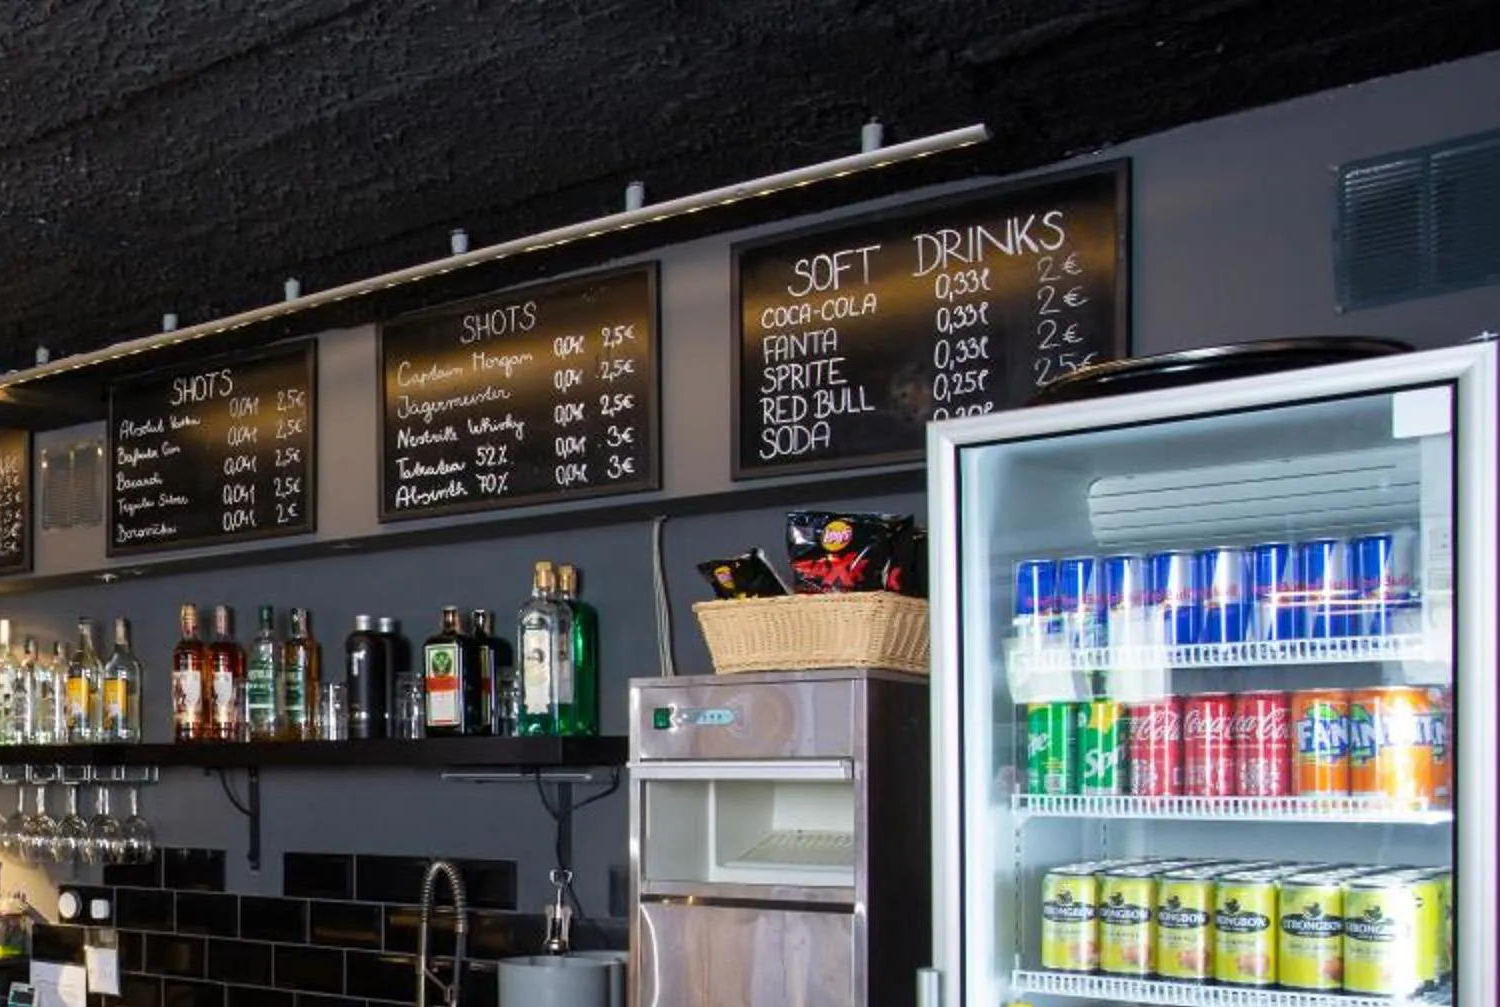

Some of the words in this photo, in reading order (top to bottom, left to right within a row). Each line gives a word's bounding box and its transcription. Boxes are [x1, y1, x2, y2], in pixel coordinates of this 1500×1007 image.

[788, 245, 881, 297] SOFT
[913, 211, 1066, 277] DRINKS
[460, 301, 537, 344] SHOTS
[761, 293, 877, 329] COCA-COLA
[763, 328, 837, 364] FANTA
[472, 351, 533, 378] Morgan
[761, 357, 848, 395] SPRITE
[171, 368, 233, 405] SHOTS
[759, 396, 807, 425] RED
[814, 386, 876, 419] BULL
[475, 444, 508, 466] 52%
[759, 422, 831, 460] SODA
[475, 472, 509, 494] 70%
[1297, 716, 1350, 752] FAN
